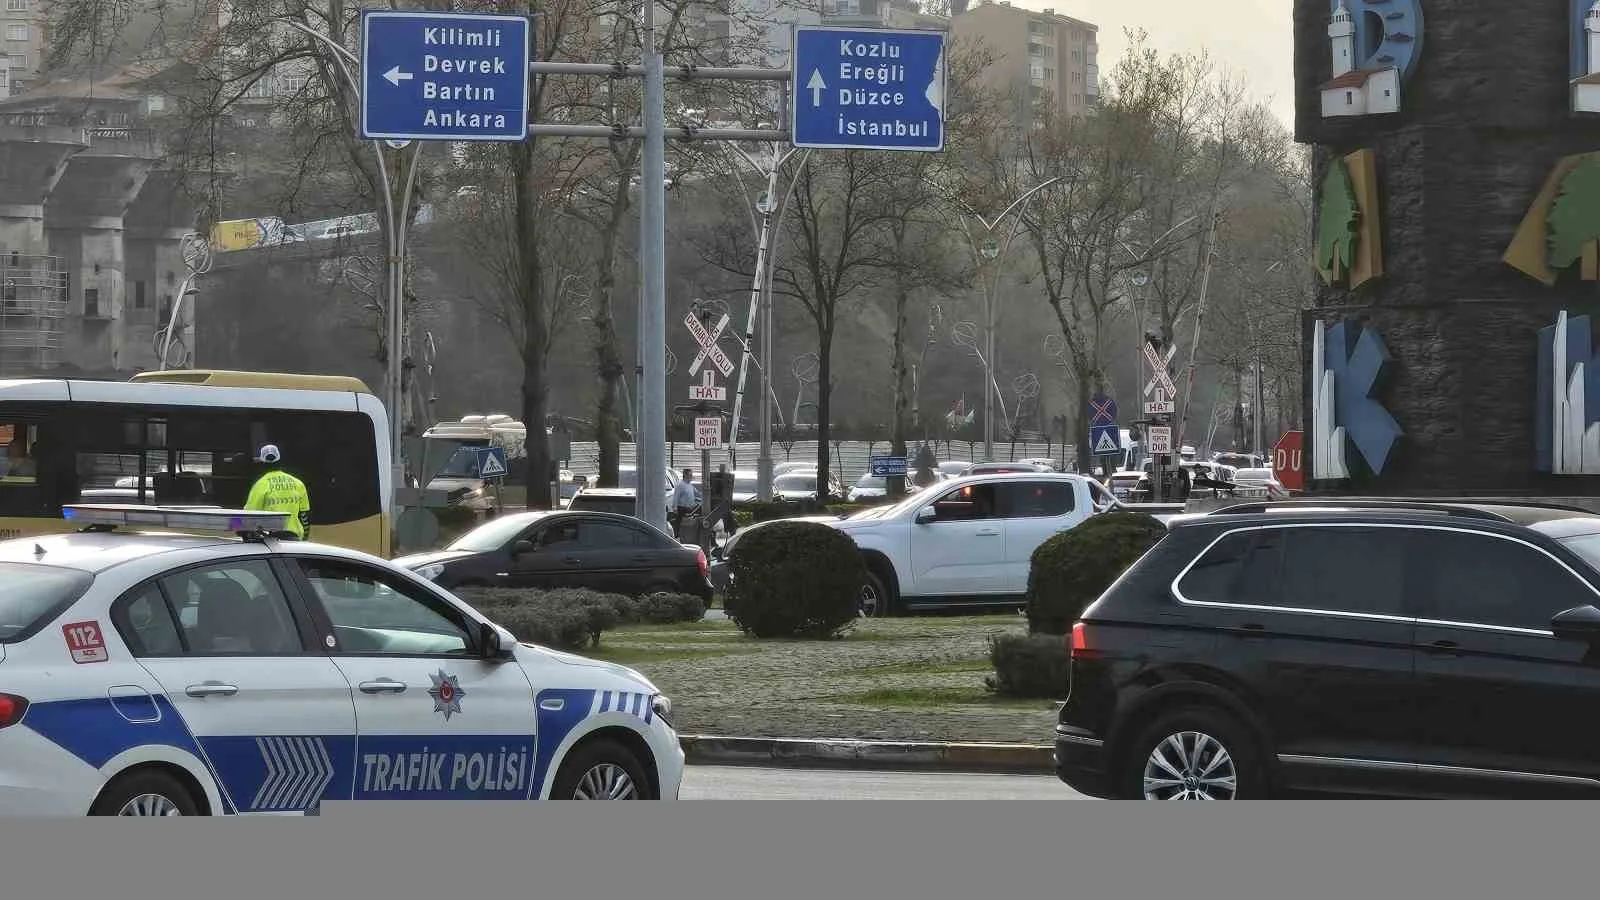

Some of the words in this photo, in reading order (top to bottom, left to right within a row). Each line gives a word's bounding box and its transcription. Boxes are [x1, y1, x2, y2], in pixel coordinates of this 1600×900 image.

[424, 27, 501, 47] Kilimli
[840, 39, 900, 58] Kozlu
[424, 54, 505, 74] Devrek
[840, 63, 904, 85] Ereğli
[423, 81, 495, 100] Bartın
[840, 88, 904, 105] Düzce
[423, 109, 505, 128] Ankara
[838, 113, 928, 137] İstanbul
[706, 372, 712, 387] 1
[696, 388, 720, 398] HAT
[1157, 390, 1163, 402] 1
[1150, 402, 1169, 411] HAT
[699, 437, 717, 447] DUR
[1276, 449, 1302, 471] DU
[68, 626, 99, 647] 112
[363, 746, 447, 791] TRAFİK
[450, 746, 527, 791] POLİSİ
